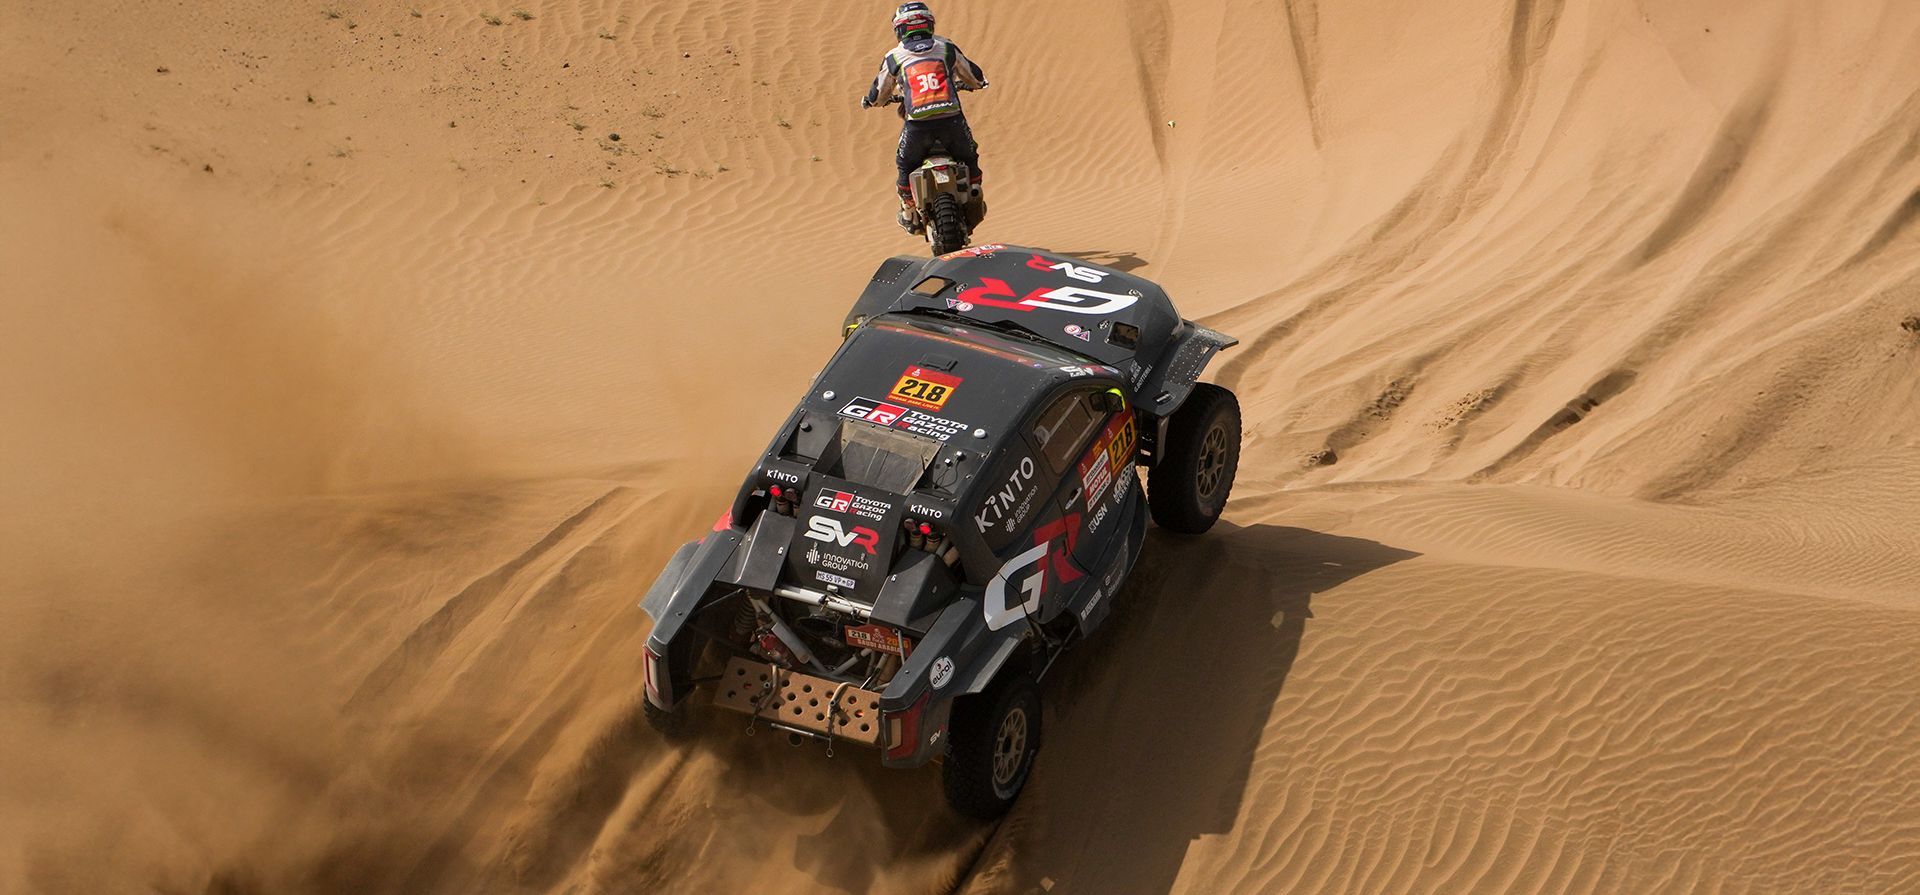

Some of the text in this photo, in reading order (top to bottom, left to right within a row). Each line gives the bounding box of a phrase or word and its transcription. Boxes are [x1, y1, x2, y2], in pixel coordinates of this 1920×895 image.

[917, 73, 940, 93] 36
[1026, 254, 1110, 283] SVR
[957, 277, 1139, 314] GR
[898, 379, 947, 402] 218
[842, 404, 898, 424] GR
[910, 410, 969, 431] TOYOTA
[895, 422, 950, 441] Racing
[901, 416, 958, 435] GAZOO
[1112, 421, 1133, 465] 218
[816, 496, 849, 511] GR
[851, 502, 886, 515] GAZOO
[854, 495, 891, 510] TOYOTA
[850, 508, 883, 522] Racing
[1095, 503, 1108, 527] USN
[803, 515, 880, 555] SVR
[822, 559, 848, 572] GROUP
[984, 512, 1086, 631] GR
[851, 630, 868, 639] 218
[857, 639, 877, 650] SAUDI
[886, 637, 910, 649] 206
[932, 660, 953, 685] eurol
